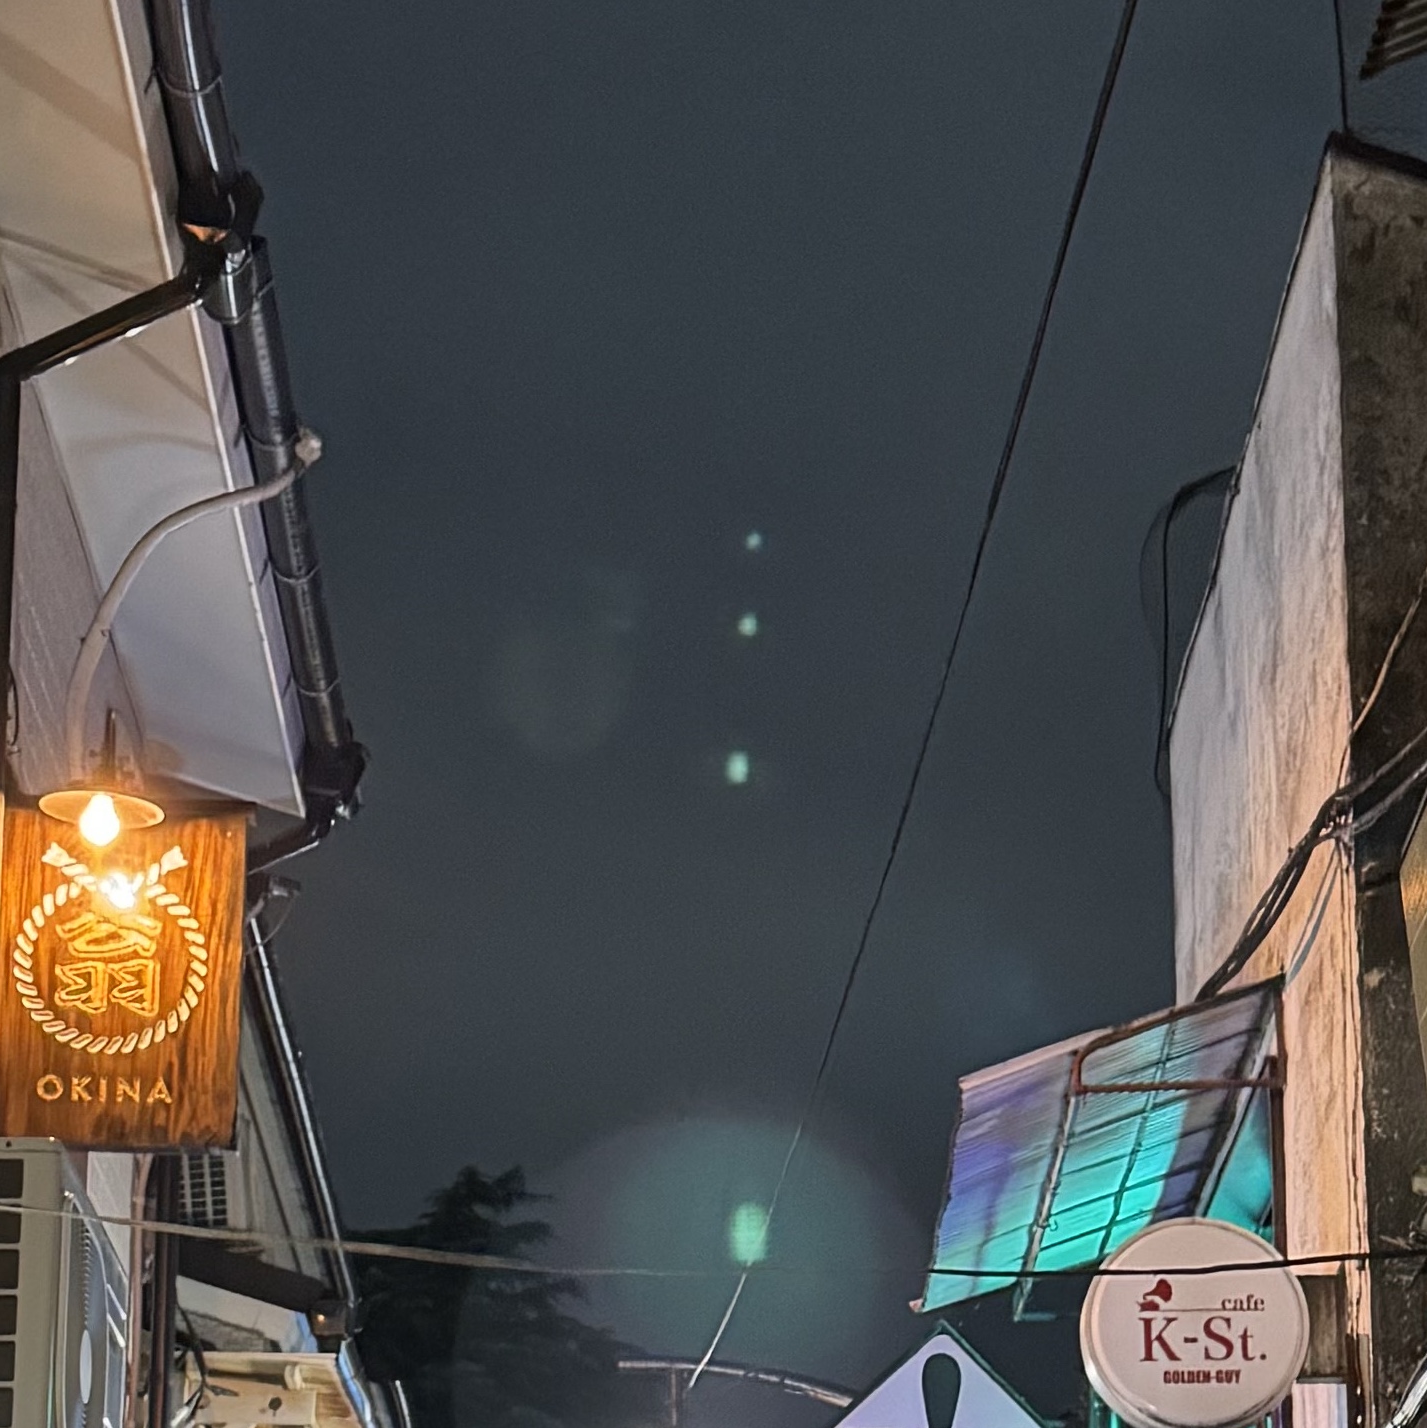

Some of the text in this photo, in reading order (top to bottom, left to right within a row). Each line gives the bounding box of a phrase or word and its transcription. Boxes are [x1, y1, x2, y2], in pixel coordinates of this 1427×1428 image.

[36, 1073, 173, 1104] OKINA
[1220, 1293, 1266, 1312] cafe
[1138, 1315, 1267, 1362] K-St.
